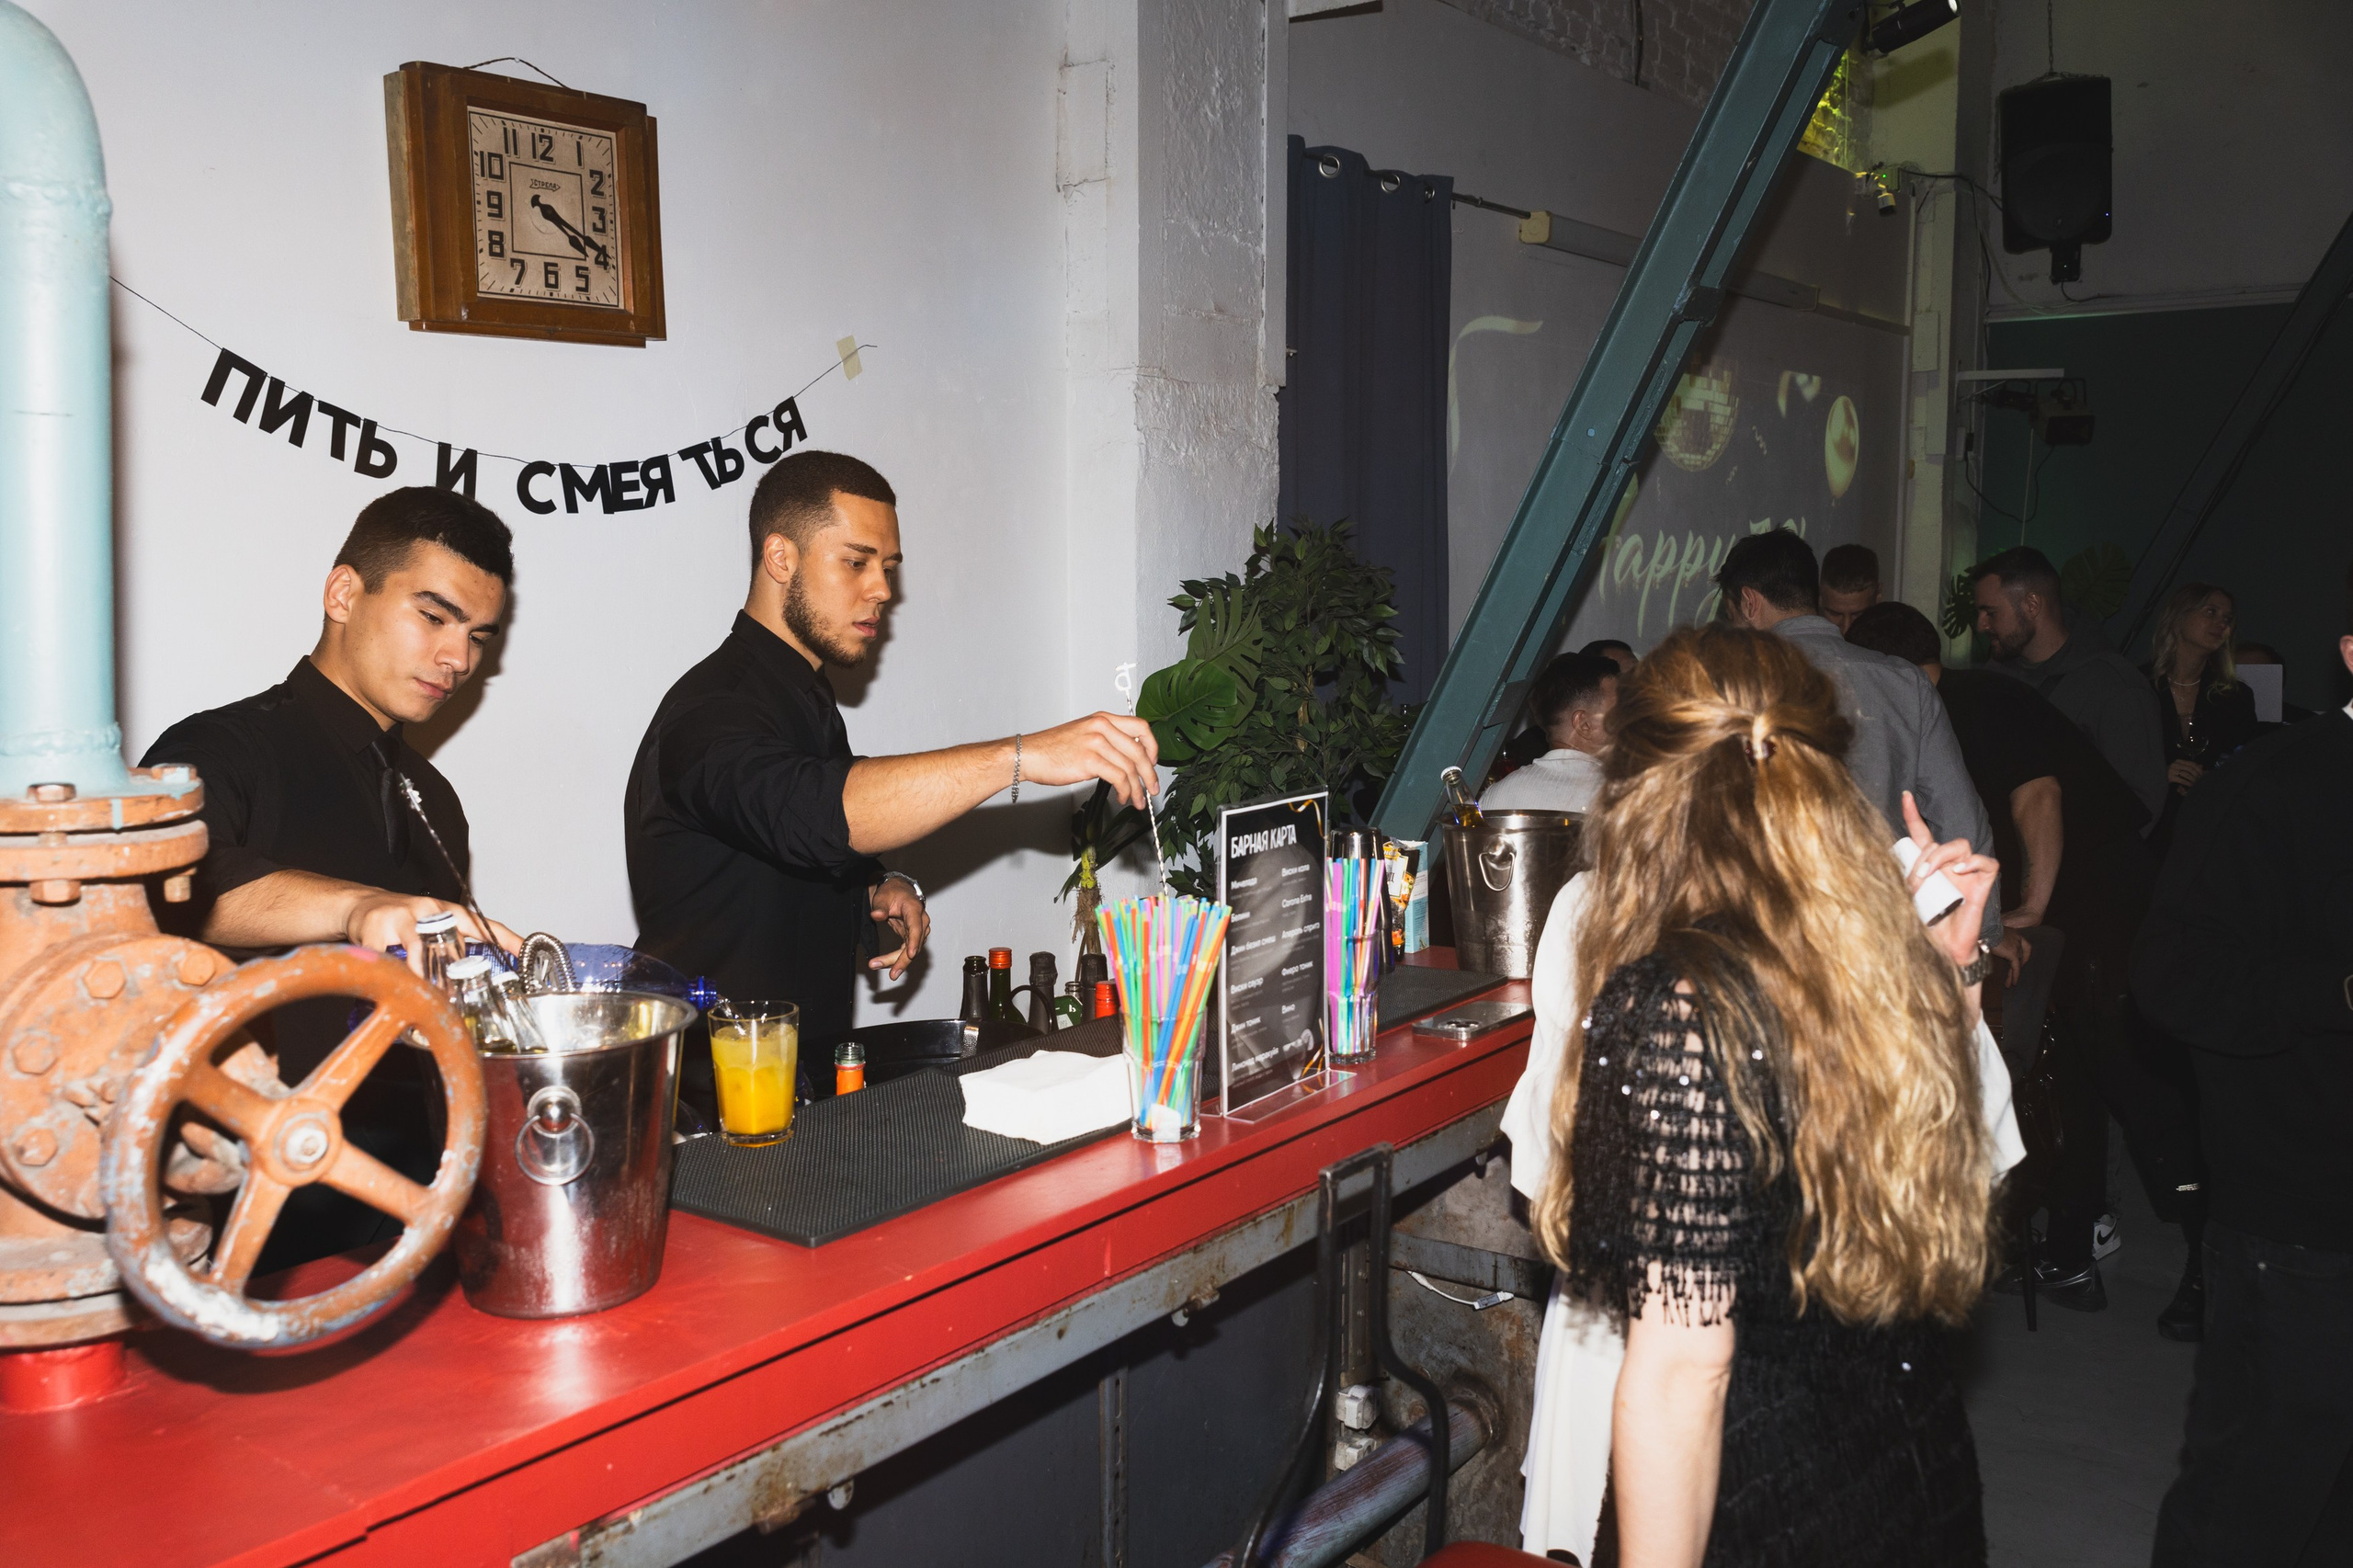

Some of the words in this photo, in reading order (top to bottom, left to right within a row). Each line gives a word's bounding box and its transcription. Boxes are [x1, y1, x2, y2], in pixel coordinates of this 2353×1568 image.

[504, 127, 517, 155] 11
[532, 132, 554, 163] 12
[576, 140, 583, 166] 1
[480, 151, 504, 180] 10
[590, 169, 604, 197] 2
[487, 190, 503, 219] 9
[592, 206, 607, 233] 3
[488, 231, 505, 258] 8
[594, 244, 609, 270] 4
[510, 258, 526, 286] 7
[544, 262, 559, 290] 6
[575, 266, 589, 292] 5
[200, 347, 398, 479] ПИТЬ
[436, 441, 478, 502] И
[1231, 830, 1269, 858] БАРНАЯ
[1270, 824, 1297, 849] КАРТА
